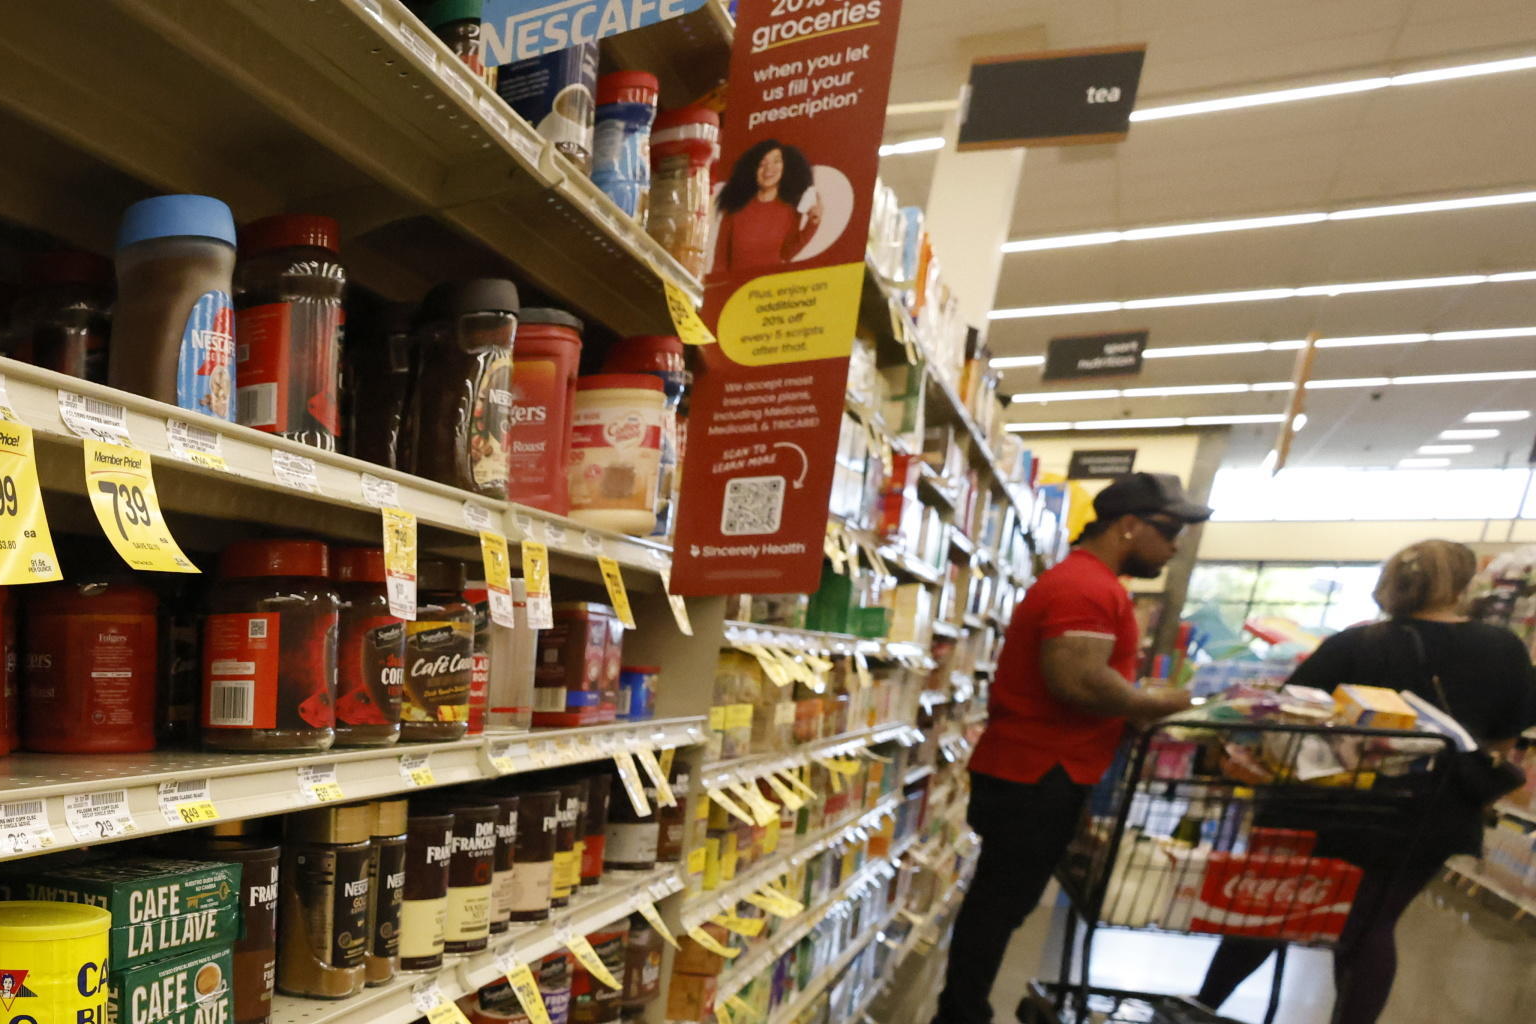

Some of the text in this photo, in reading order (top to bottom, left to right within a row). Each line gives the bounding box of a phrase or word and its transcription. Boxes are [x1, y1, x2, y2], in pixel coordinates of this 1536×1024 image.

[751, 1, 881, 54] groceries
[753, 44, 870, 82] when you let
[763, 70, 854, 102] us fill your
[1085, 84, 1121, 104] tea
[777, 284, 809, 297] enjoy
[812, 282, 828, 290] an
[756, 297, 816, 314] additional
[762, 312, 806, 327] 20% off
[740, 333, 771, 343] every
[786, 326, 824, 338] scripts
[752, 345, 778, 356] after
[94, 451, 142, 468] Member Price!
[723, 444, 767, 460] SCAN TO
[712, 453, 777, 474] LEARN MORE
[24, 529, 37, 538] ea
[702, 543, 806, 559] Sincerely Health
[129, 884, 180, 924] CAFE
[127, 909, 218, 958] LA LLAVE
